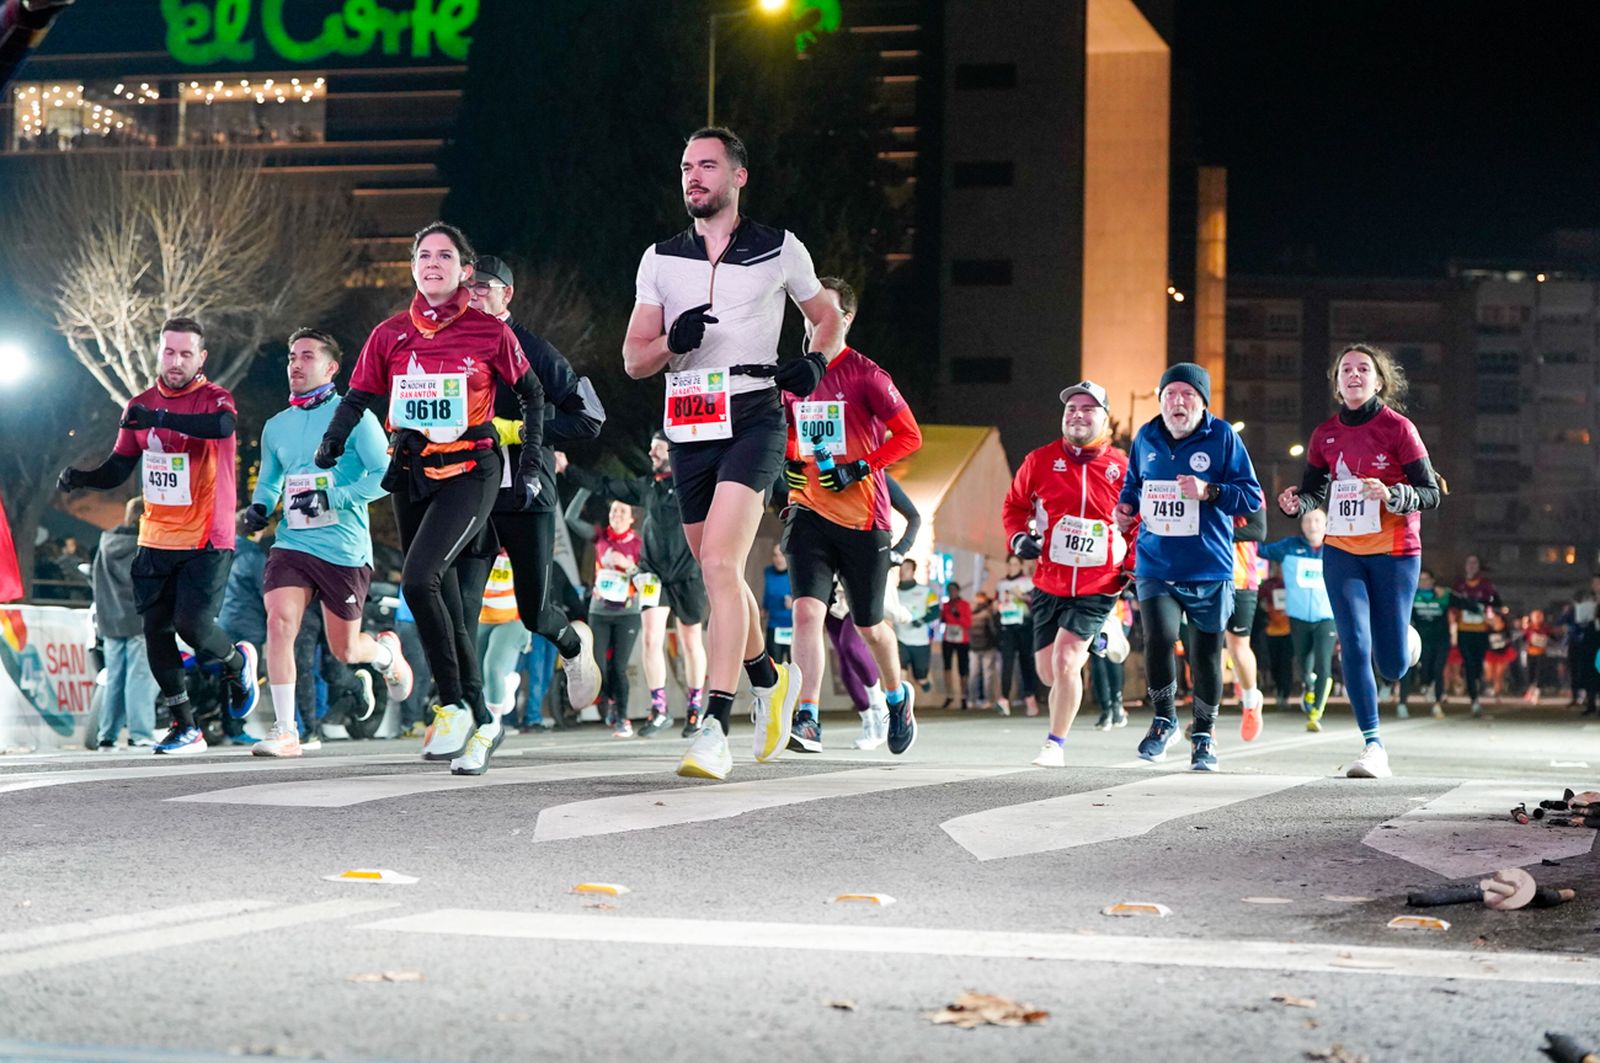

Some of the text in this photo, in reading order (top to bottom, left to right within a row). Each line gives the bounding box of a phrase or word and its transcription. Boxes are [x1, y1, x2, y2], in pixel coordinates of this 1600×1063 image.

[405, 399, 451, 420] 9618
[802, 420, 834, 437] 9000
[149, 470, 177, 487] 4379
[1153, 501, 1184, 517] 7419
[1339, 500, 1365, 516] 1871
[1065, 534, 1094, 553] 1872
[46, 643, 85, 675] SAN
